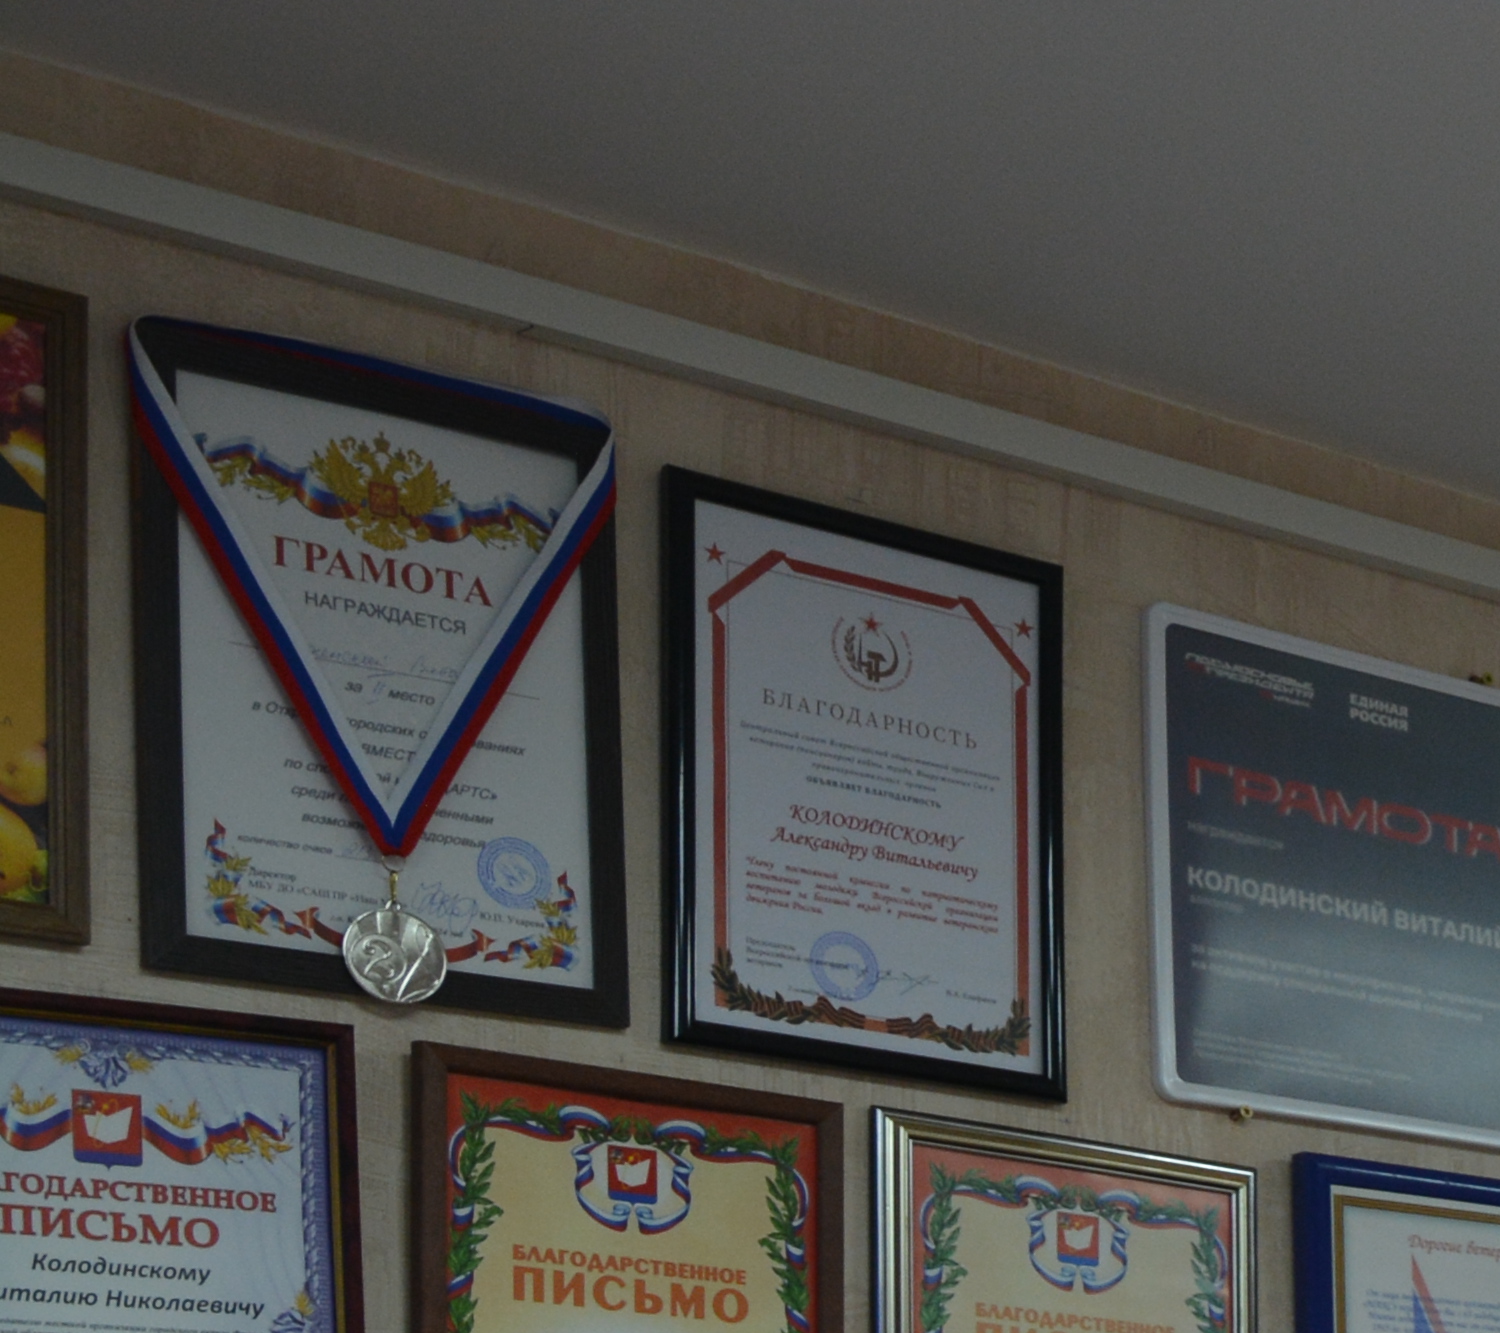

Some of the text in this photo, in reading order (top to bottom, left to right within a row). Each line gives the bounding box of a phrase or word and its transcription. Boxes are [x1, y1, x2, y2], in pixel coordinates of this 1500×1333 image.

[273, 535, 494, 608] ГРАМОТА
[304, 591, 467, 635] НАГРАЖДАЕТСЯ
[389, 687, 435, 706] место
[1349, 693, 1409, 717] ЕДИНАЯ
[763, 688, 978, 750] БЛАГОДАРНОСТЬ
[1349, 707, 1409, 732] РОССИЯ
[790, 805, 965, 852] КОЛОДИНСКОМУ
[770, 827, 978, 882] Александру Витальевичу
[1187, 865, 1388, 926] КОЛОДИНСКИЙ
[0, 1172, 277, 1213] ГОДАРСТВЕННОЕ
[0, 1205, 219, 1249] ПИСЬМО
[31, 1253, 211, 1284] Колодинскому
[513, 1244, 746, 1284] БЛАГОДАРСТВЕННОЕ
[0, 1287, 265, 1320] италию Николаевичу
[513, 1266, 749, 1323] ПИСЬМО
